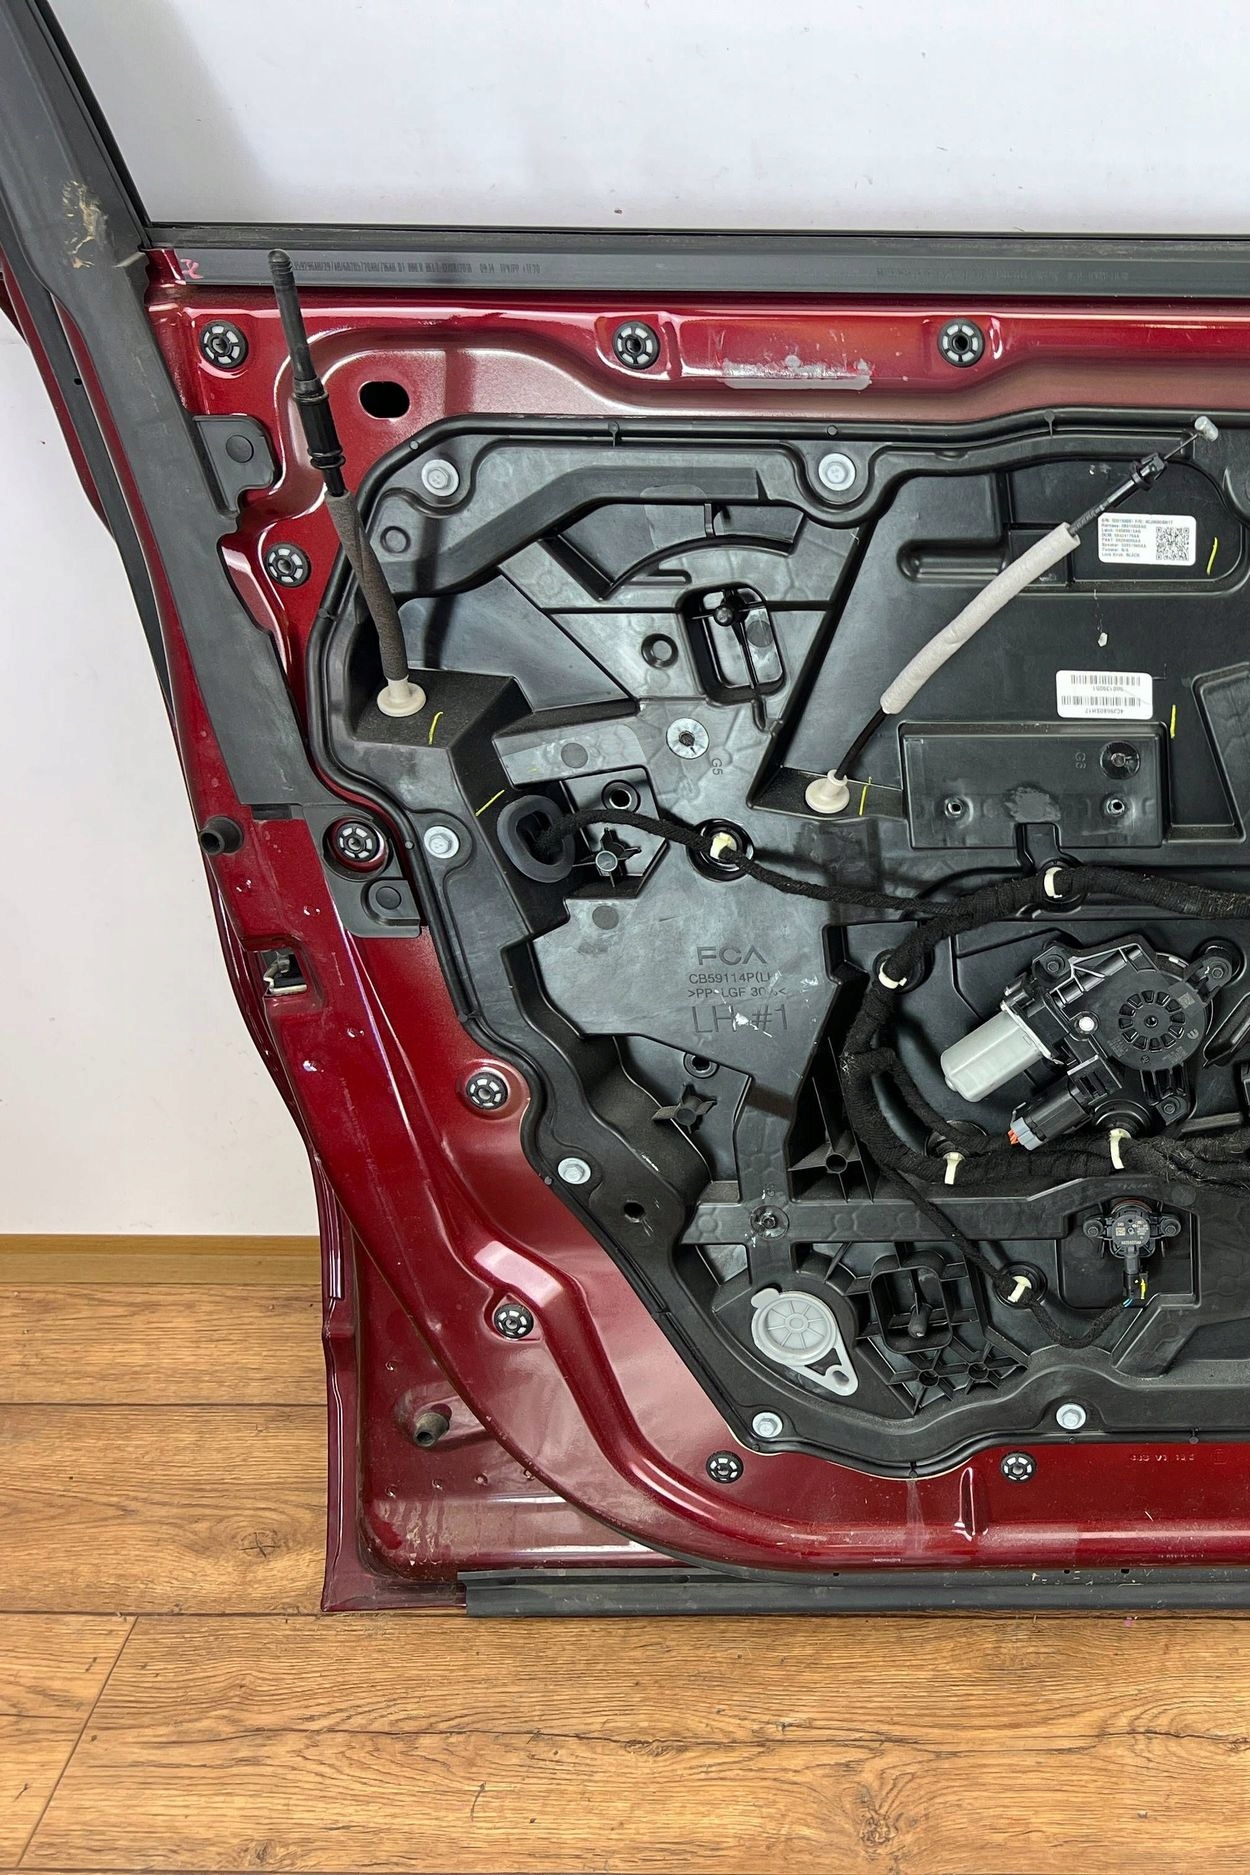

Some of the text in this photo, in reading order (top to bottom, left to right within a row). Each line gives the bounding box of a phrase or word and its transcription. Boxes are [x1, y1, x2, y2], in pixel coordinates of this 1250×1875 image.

[712, 757, 724, 776] G5
[696, 945, 768, 966] FCA
[691, 1004, 788, 1033] LH #1
